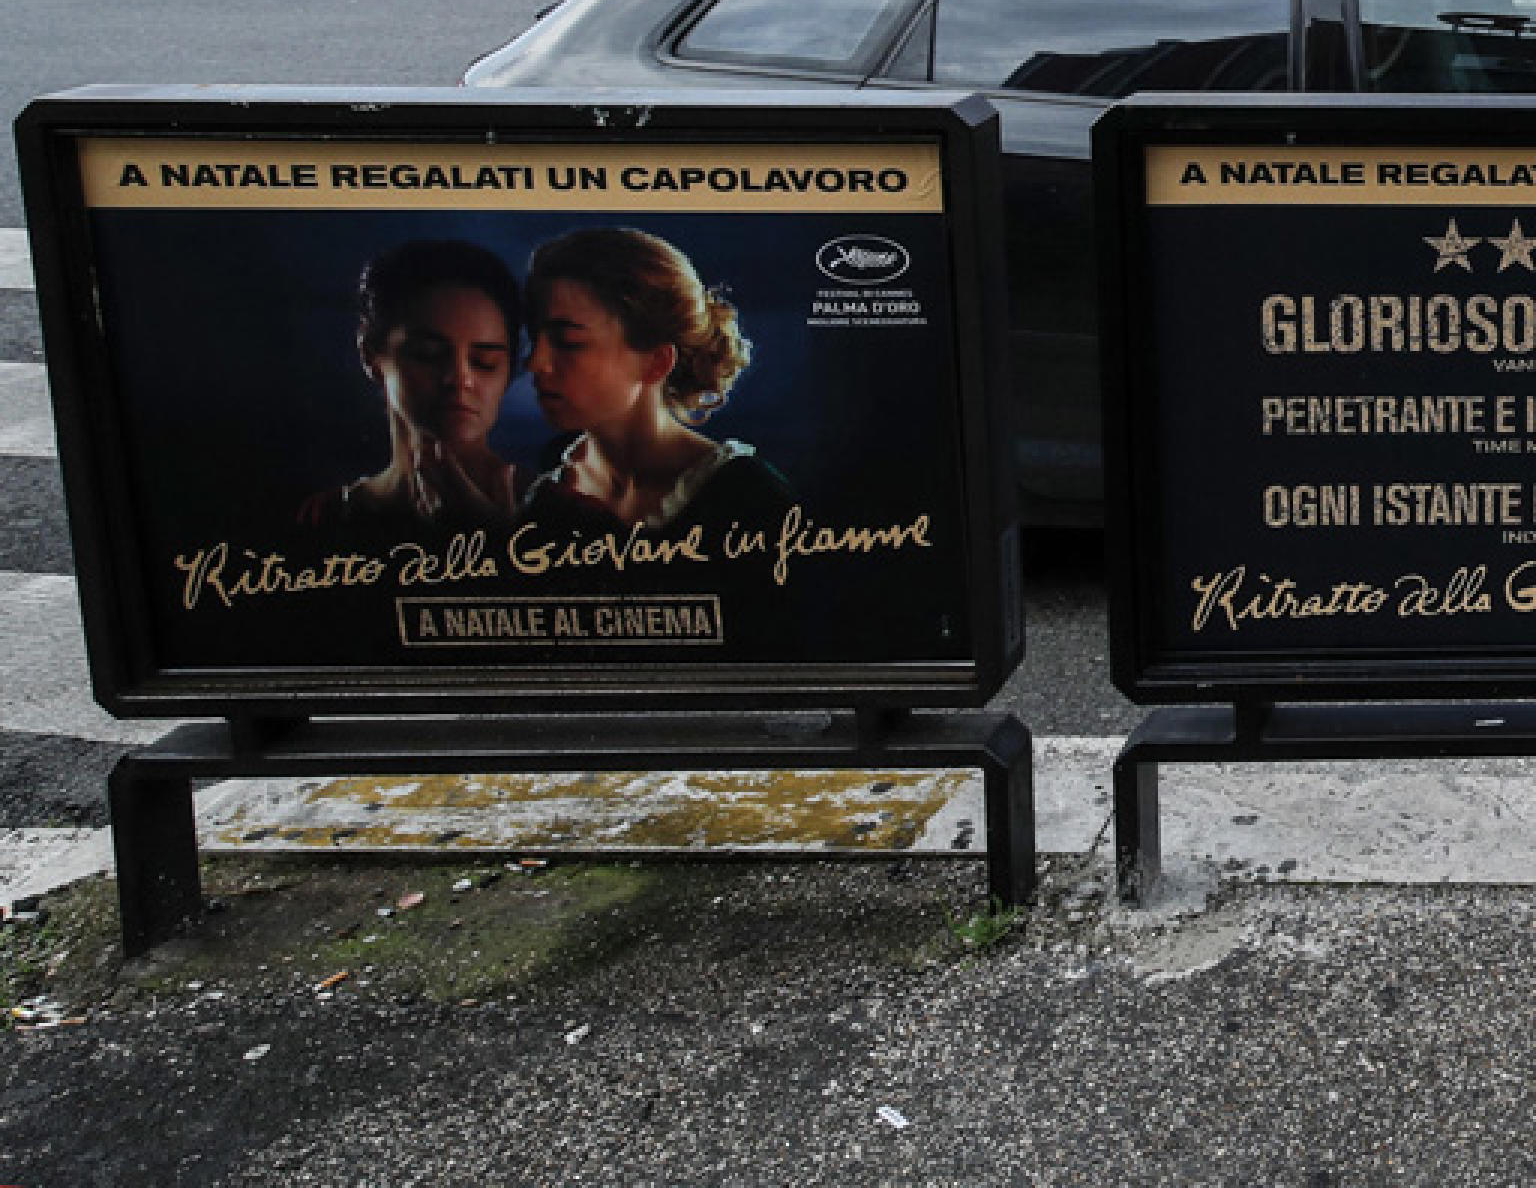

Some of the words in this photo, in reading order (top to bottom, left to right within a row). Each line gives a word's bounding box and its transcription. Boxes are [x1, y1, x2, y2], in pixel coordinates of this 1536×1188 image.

[120, 164, 147, 187] A
[159, 164, 318, 188] NATALE
[330, 165, 534, 190] REGALATI
[548, 167, 607, 190] UN
[620, 167, 908, 193] CAPOLAVORO
[1179, 162, 1207, 184] A
[1220, 162, 1366, 185] NATALE
[813, 302, 868, 315] PALMA
[873, 301, 922, 315] D'ORO
[1262, 294, 1536, 355] GLORIOSO
[1262, 395, 1486, 433] PENETRANTE
[1497, 395, 1516, 433] E
[1472, 440, 1522, 454] TIME
[1263, 484, 1360, 528] OGNI
[1373, 483, 1522, 526] ISTANTE
[173, 542, 388, 610] Ritratto
[724, 520, 766, 559] in
[1191, 564, 1390, 631] Ritratto
[419, 608, 439, 637] A
[446, 608, 547, 638] NATALE
[554, 609, 589, 638] AL
[596, 608, 712, 638] CINEMA
